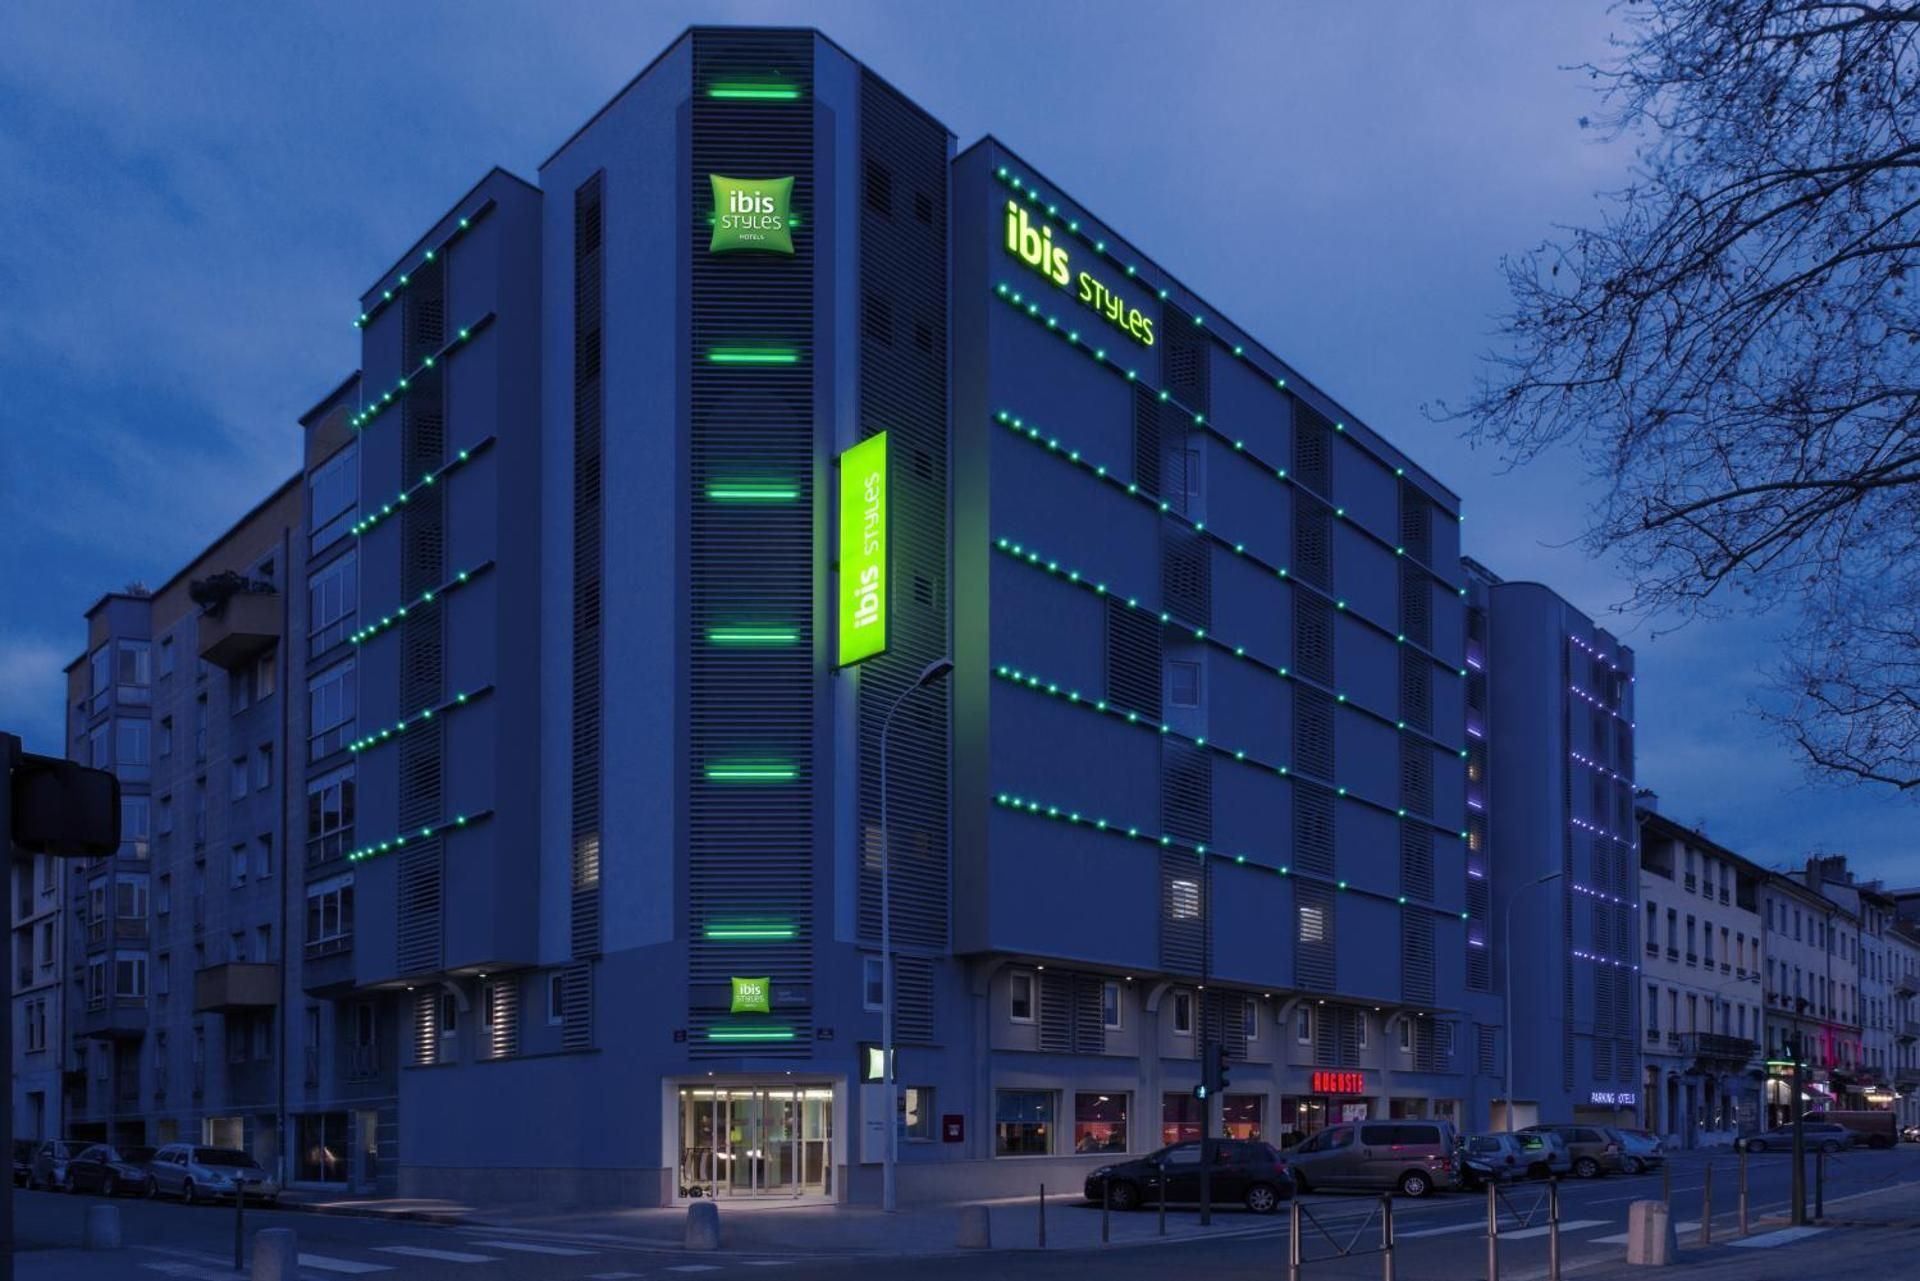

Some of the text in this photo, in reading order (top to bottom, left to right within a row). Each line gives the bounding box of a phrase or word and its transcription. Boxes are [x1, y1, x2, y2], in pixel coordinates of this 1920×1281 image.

[730, 190, 774, 213] ibis
[1008, 200, 1070, 286] ibis
[854, 564, 879, 629] ibis
[740, 983, 761, 995] ibis
[1313, 1071, 1364, 1093] AUGUSTE
[1591, 1092, 1615, 1104] PARKING
